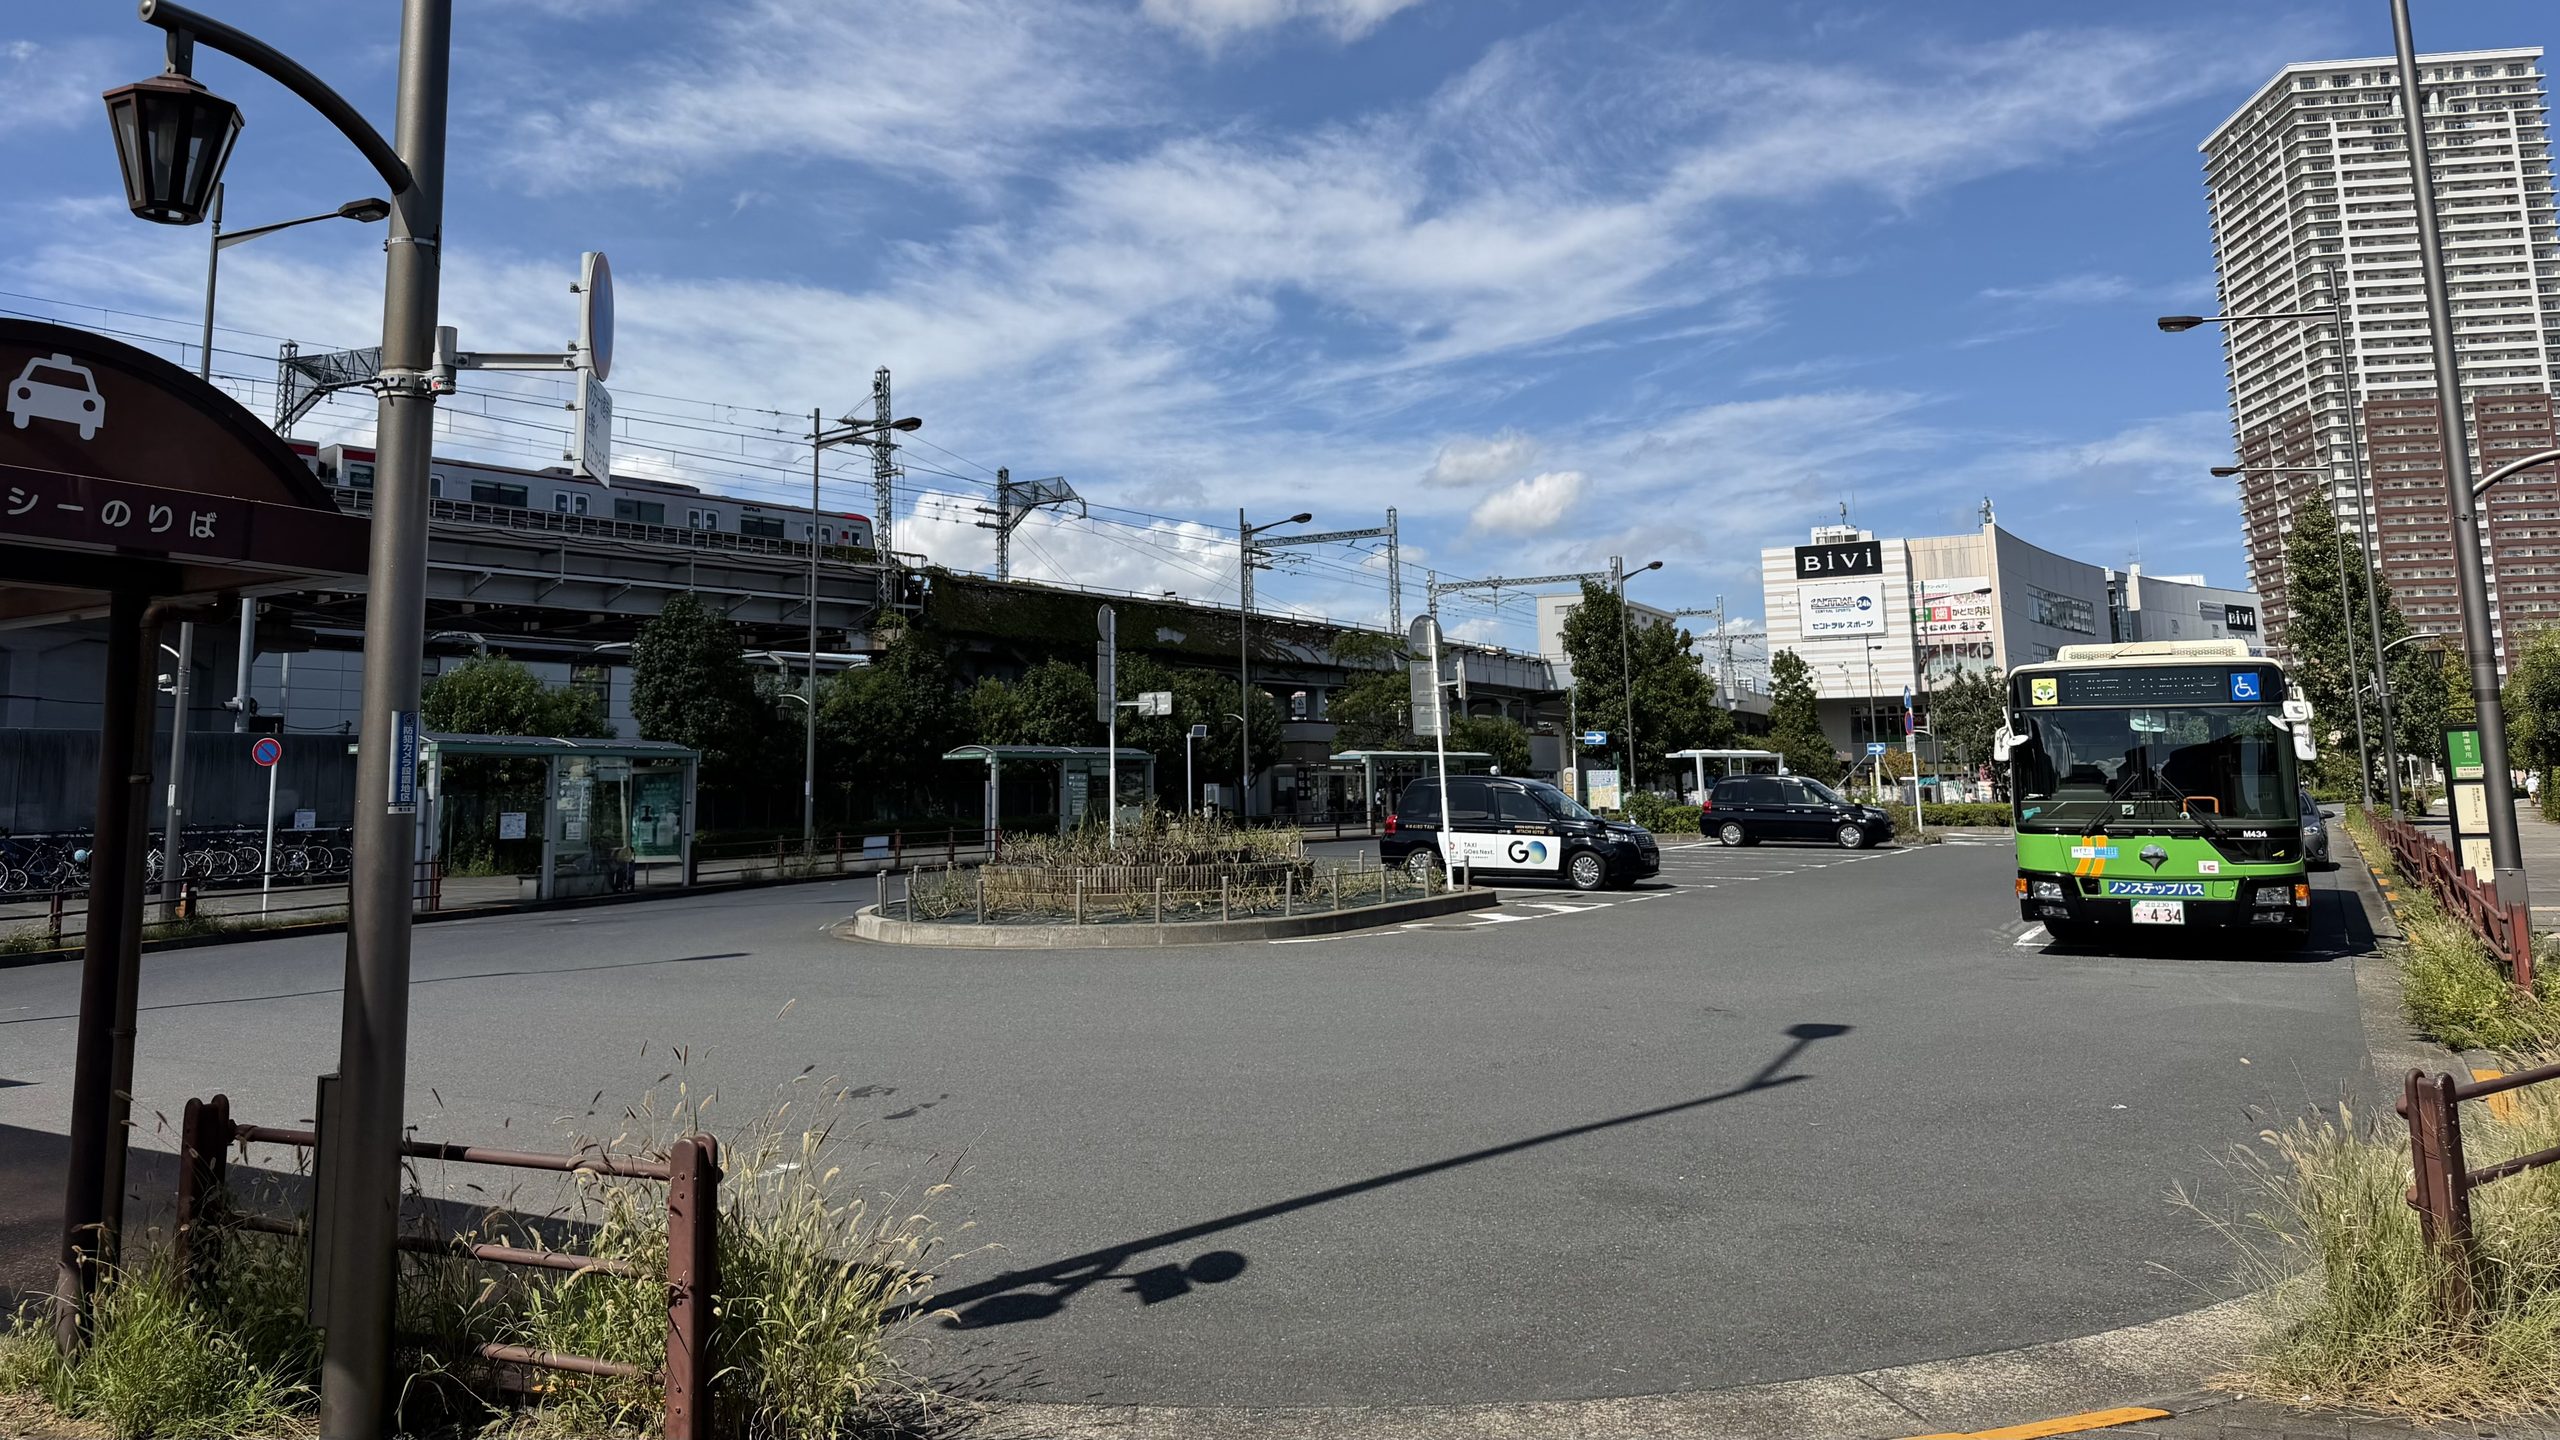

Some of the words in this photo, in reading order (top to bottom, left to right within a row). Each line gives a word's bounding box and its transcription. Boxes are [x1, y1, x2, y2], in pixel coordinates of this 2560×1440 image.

[8, 487, 217, 538] シーのりば
[1803, 548, 1874, 572] BiVi
[2228, 610, 2254, 626] BiVi
[2243, 830, 2268, 838] M434
[2109, 882, 2205, 896] ノンステップバス
